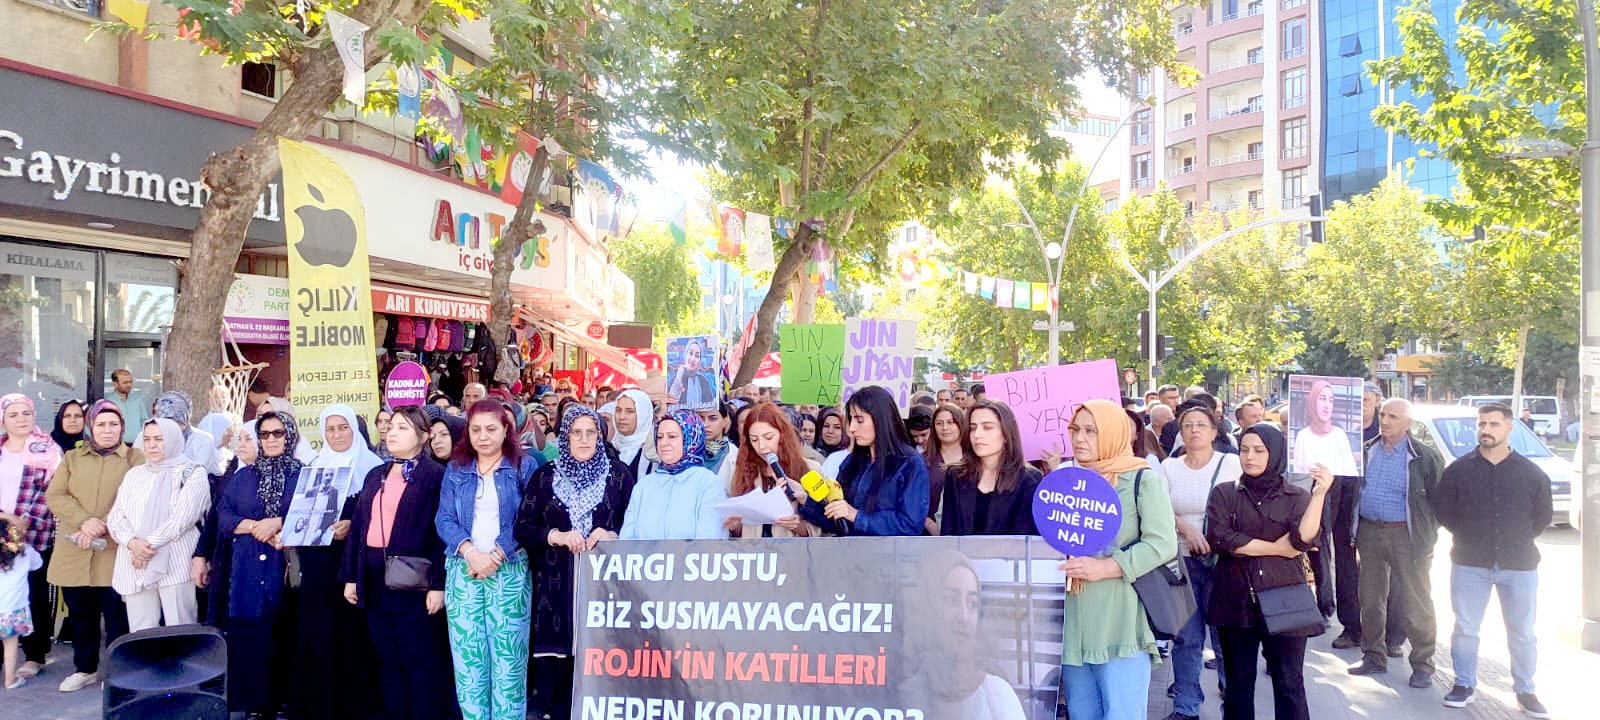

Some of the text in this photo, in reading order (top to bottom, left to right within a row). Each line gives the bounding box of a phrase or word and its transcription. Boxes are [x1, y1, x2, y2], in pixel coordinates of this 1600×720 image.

[7, 251, 84, 271] KİRALAMA
[473, 252, 494, 274] GİY
[264, 300, 290, 311] PART
[385, 293, 488, 321] ARI KURUYEMİŞ
[786, 327, 824, 353] JIN
[388, 378, 426, 389] KADINLAR
[1072, 479, 1087, 492] JI
[1038, 489, 1118, 516] QIRQIRINA
[1047, 509, 1105, 531] JINÊ RE
[588, 552, 787, 586] YARGI SUSTU,
[586, 592, 893, 633] BİZ SUSMAYACAĞIZ!
[724, 644, 886, 686] KATİLLERİ
[581, 696, 686, 720] NEDEN
